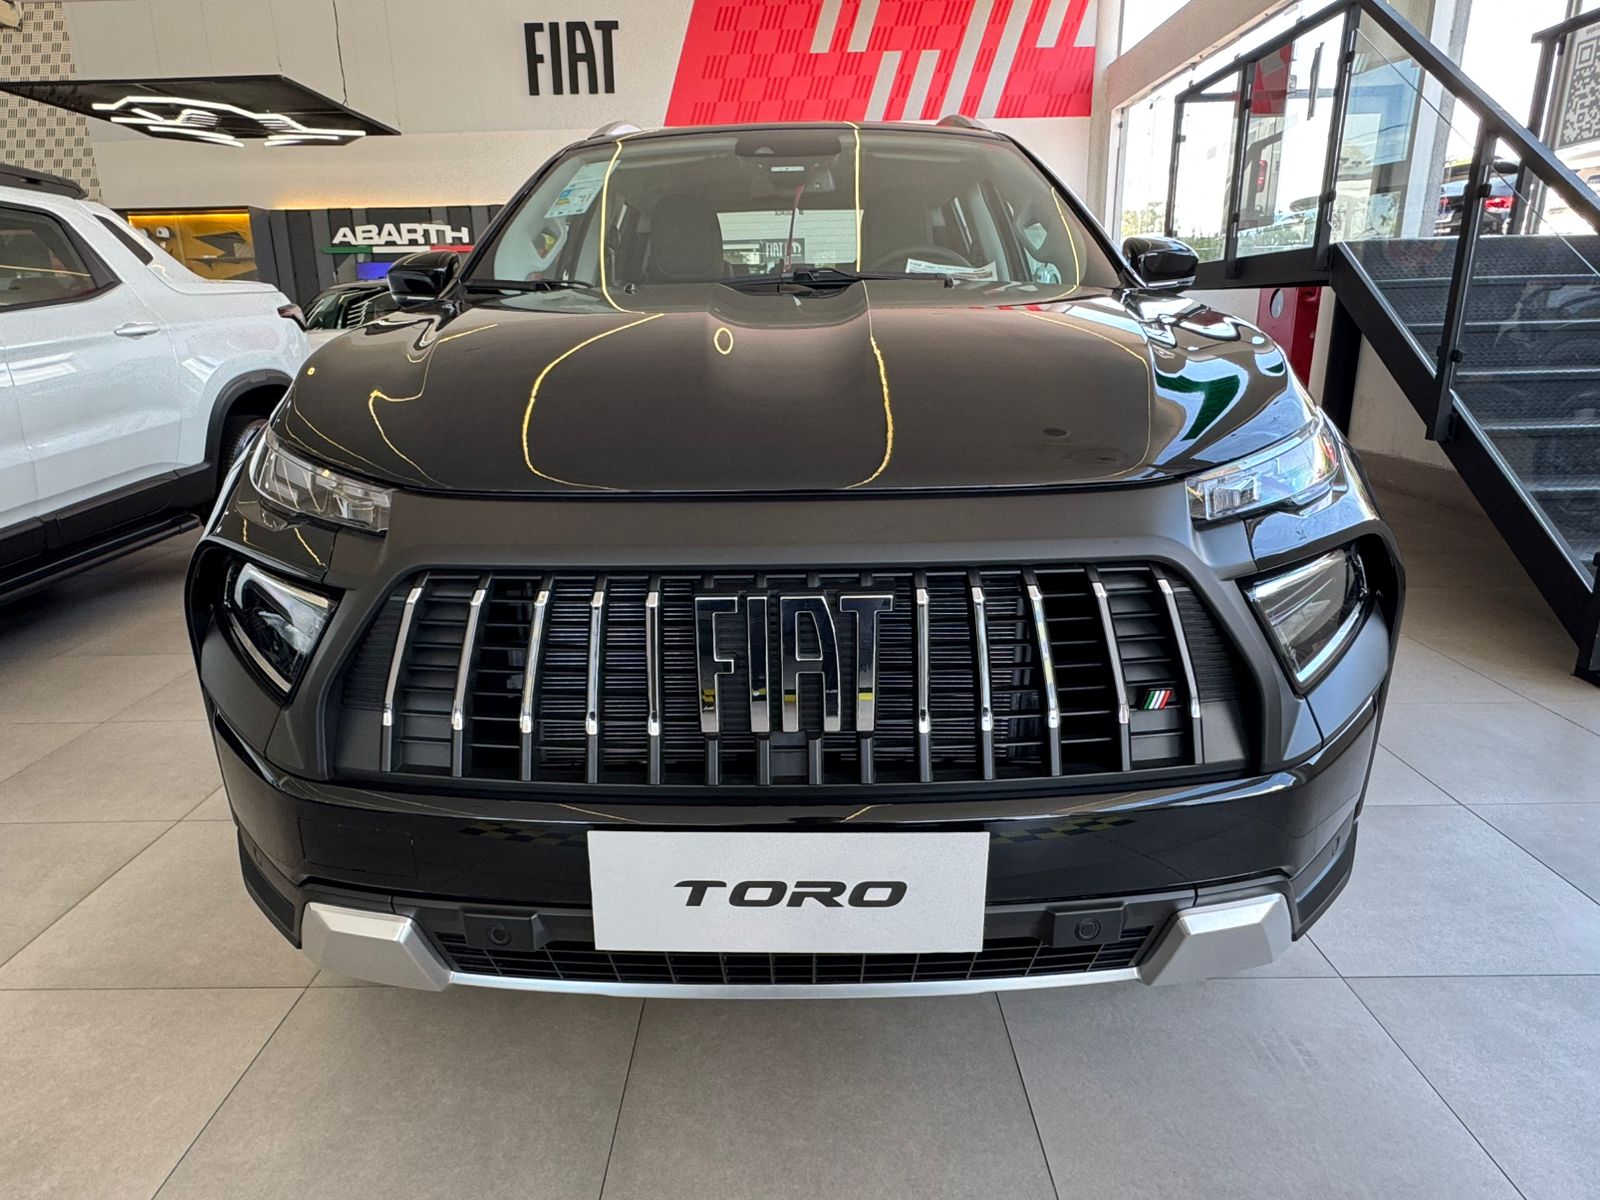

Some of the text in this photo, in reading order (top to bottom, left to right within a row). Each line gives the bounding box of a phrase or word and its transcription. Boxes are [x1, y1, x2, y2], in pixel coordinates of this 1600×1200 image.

[524, 20, 619, 96] FIAT
[332, 223, 470, 245] ABARTH
[765, 242, 784, 258] FIAT
[695, 595, 894, 733] FIAT
[673, 880, 908, 908] TORO
